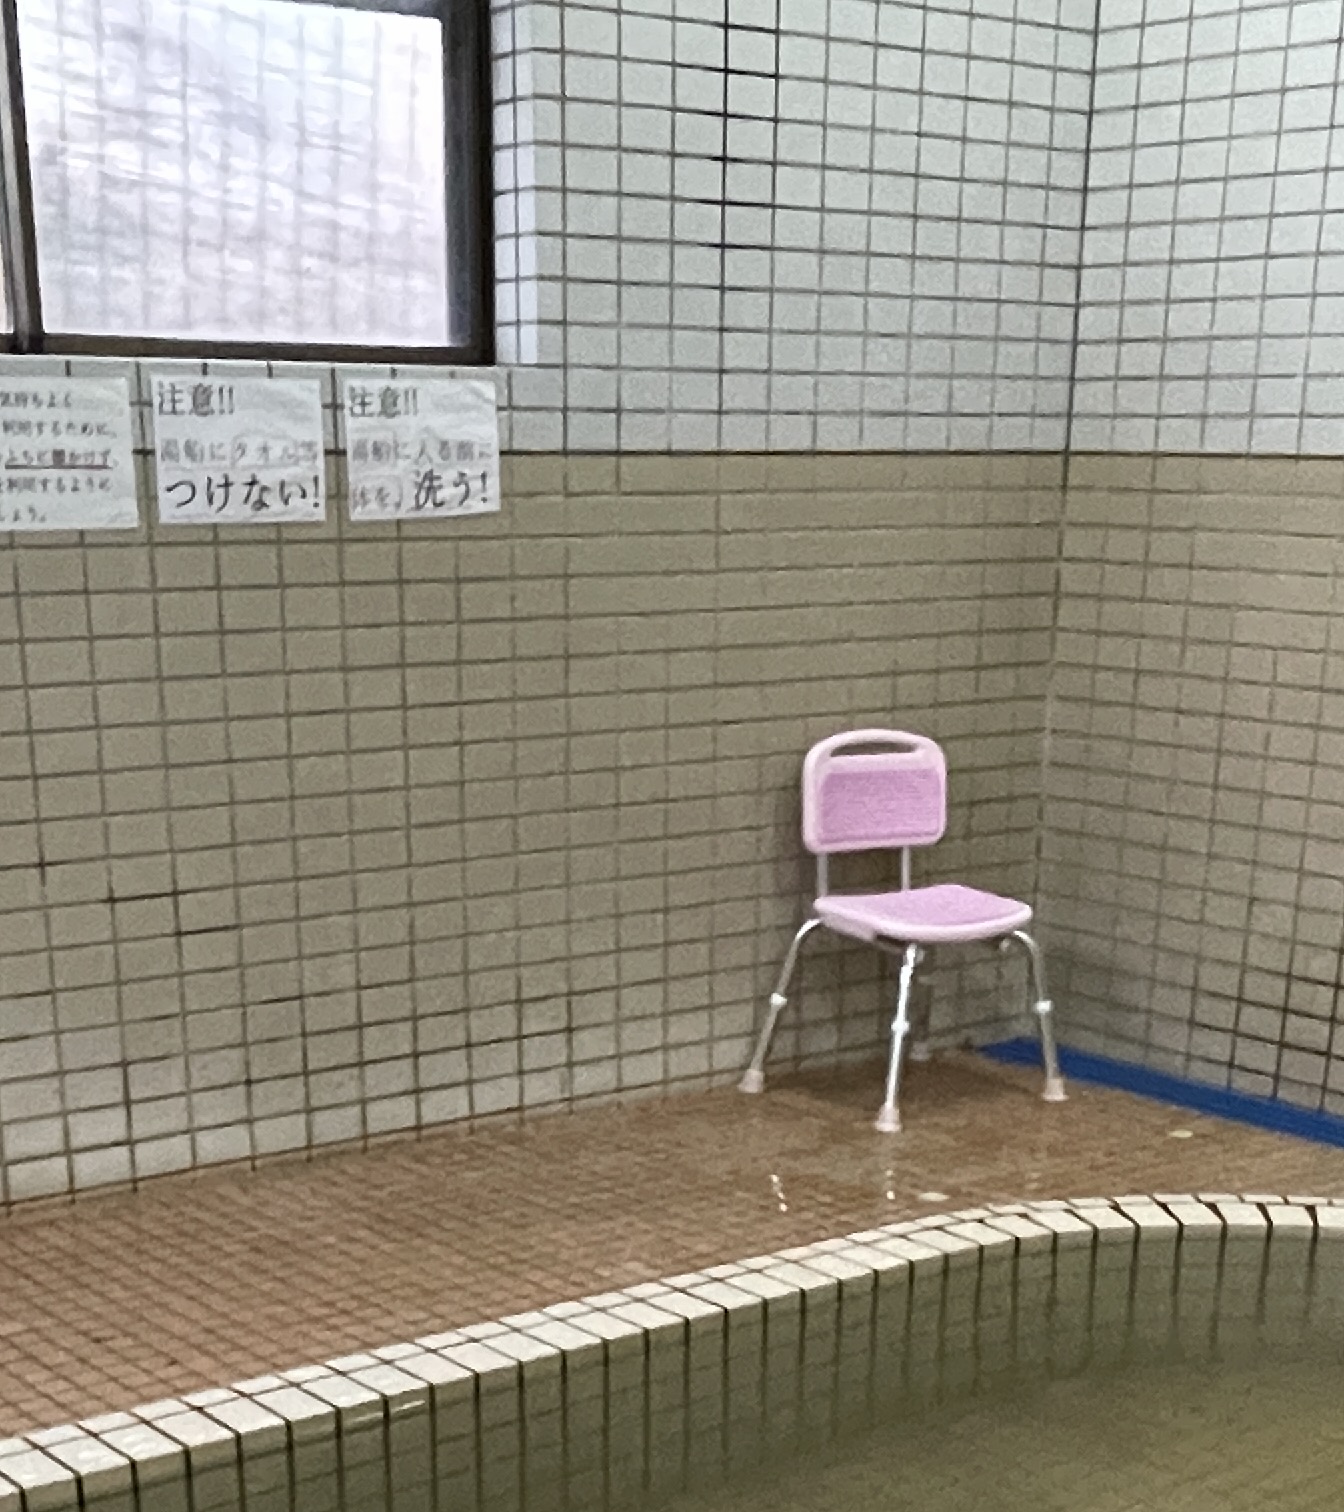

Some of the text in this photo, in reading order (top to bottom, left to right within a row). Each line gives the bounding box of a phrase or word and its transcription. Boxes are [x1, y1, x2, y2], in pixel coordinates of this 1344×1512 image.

[158, 380, 235, 417] 注意!!
[349, 384, 420, 419] 注意!!
[164, 473, 320, 514] つけない!
